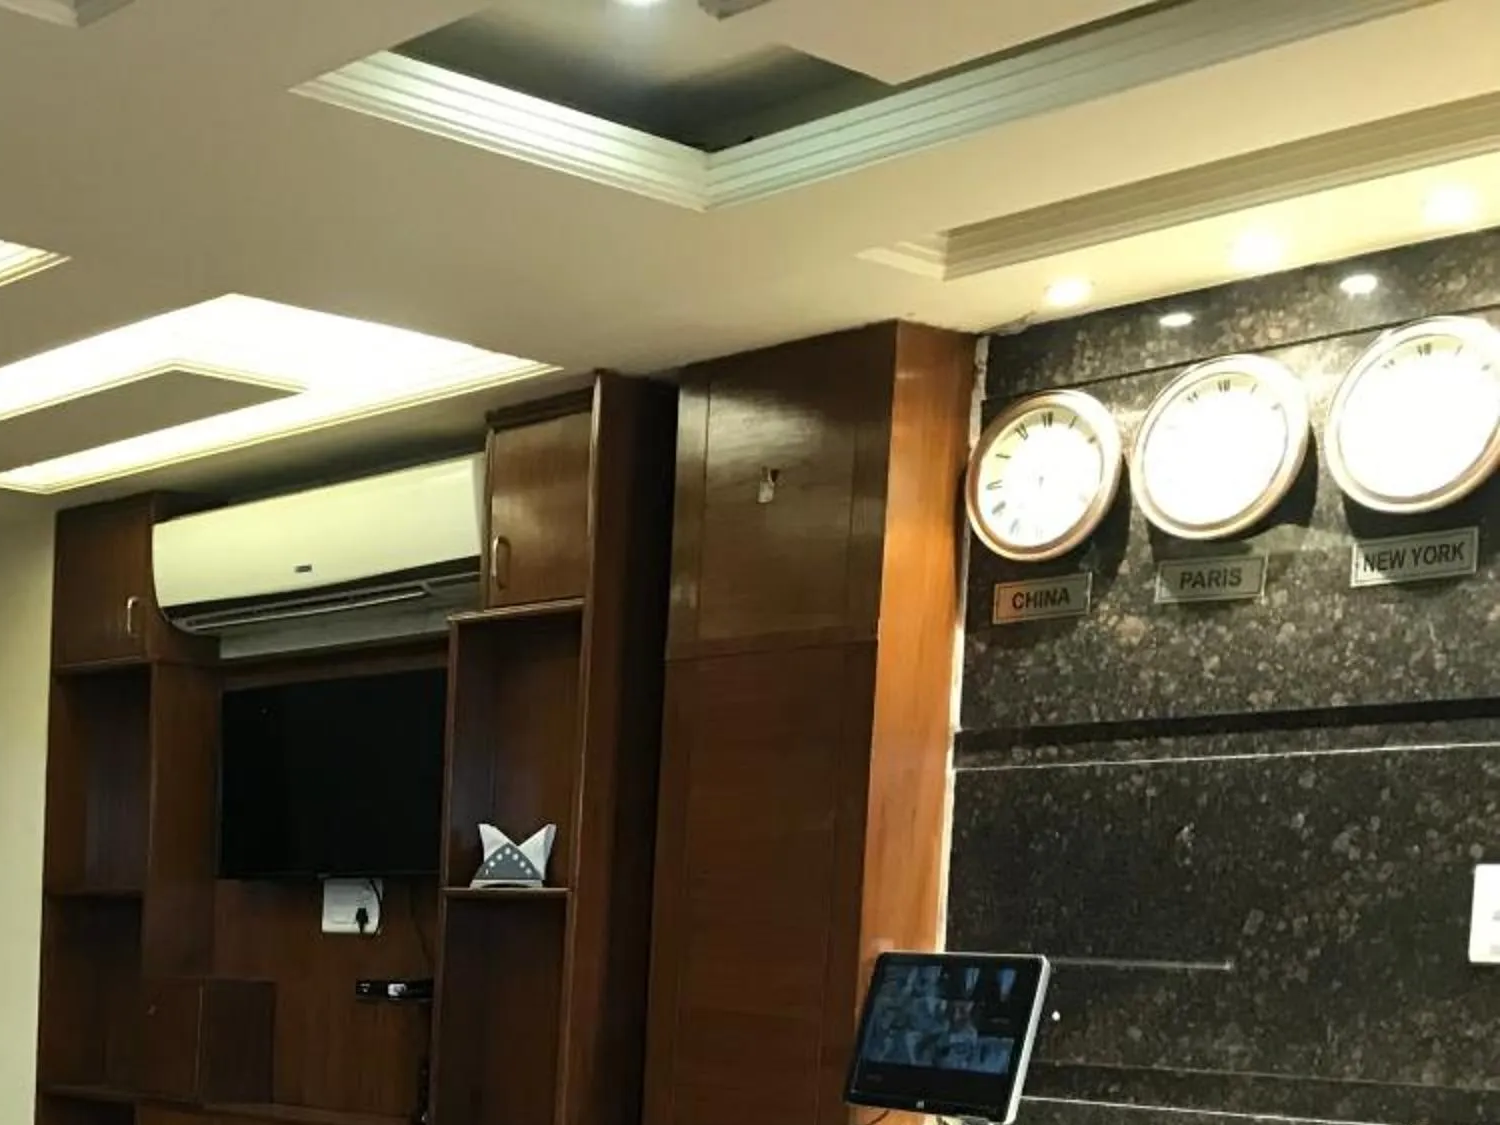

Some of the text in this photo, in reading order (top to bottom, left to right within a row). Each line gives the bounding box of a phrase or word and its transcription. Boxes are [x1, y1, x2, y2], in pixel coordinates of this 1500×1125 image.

[1364, 541, 1465, 572] NEW YORK
[1180, 567, 1242, 590] PARIS
[1012, 587, 1070, 609] CHINA
